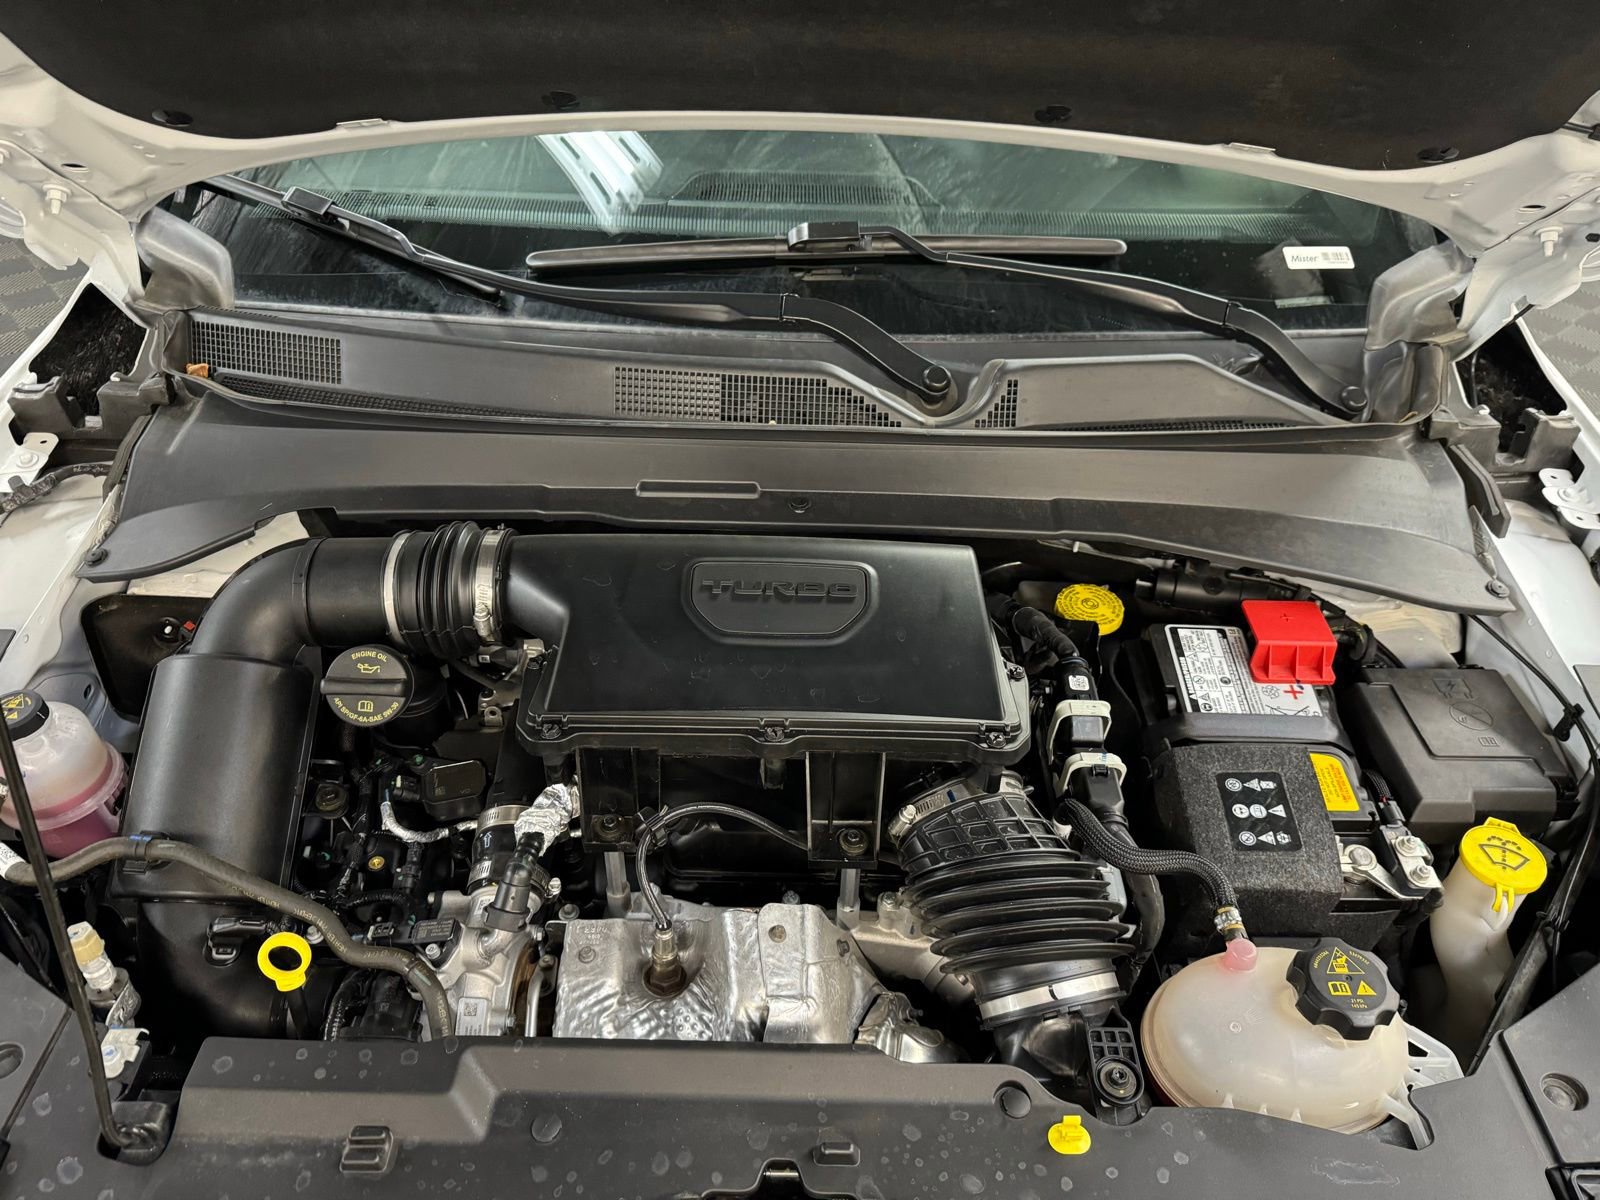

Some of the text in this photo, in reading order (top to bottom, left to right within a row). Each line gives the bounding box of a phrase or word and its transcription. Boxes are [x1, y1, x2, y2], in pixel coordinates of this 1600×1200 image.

[702, 579, 858, 598] TURBO
[351, 651, 388, 662] ENGINE OIL
